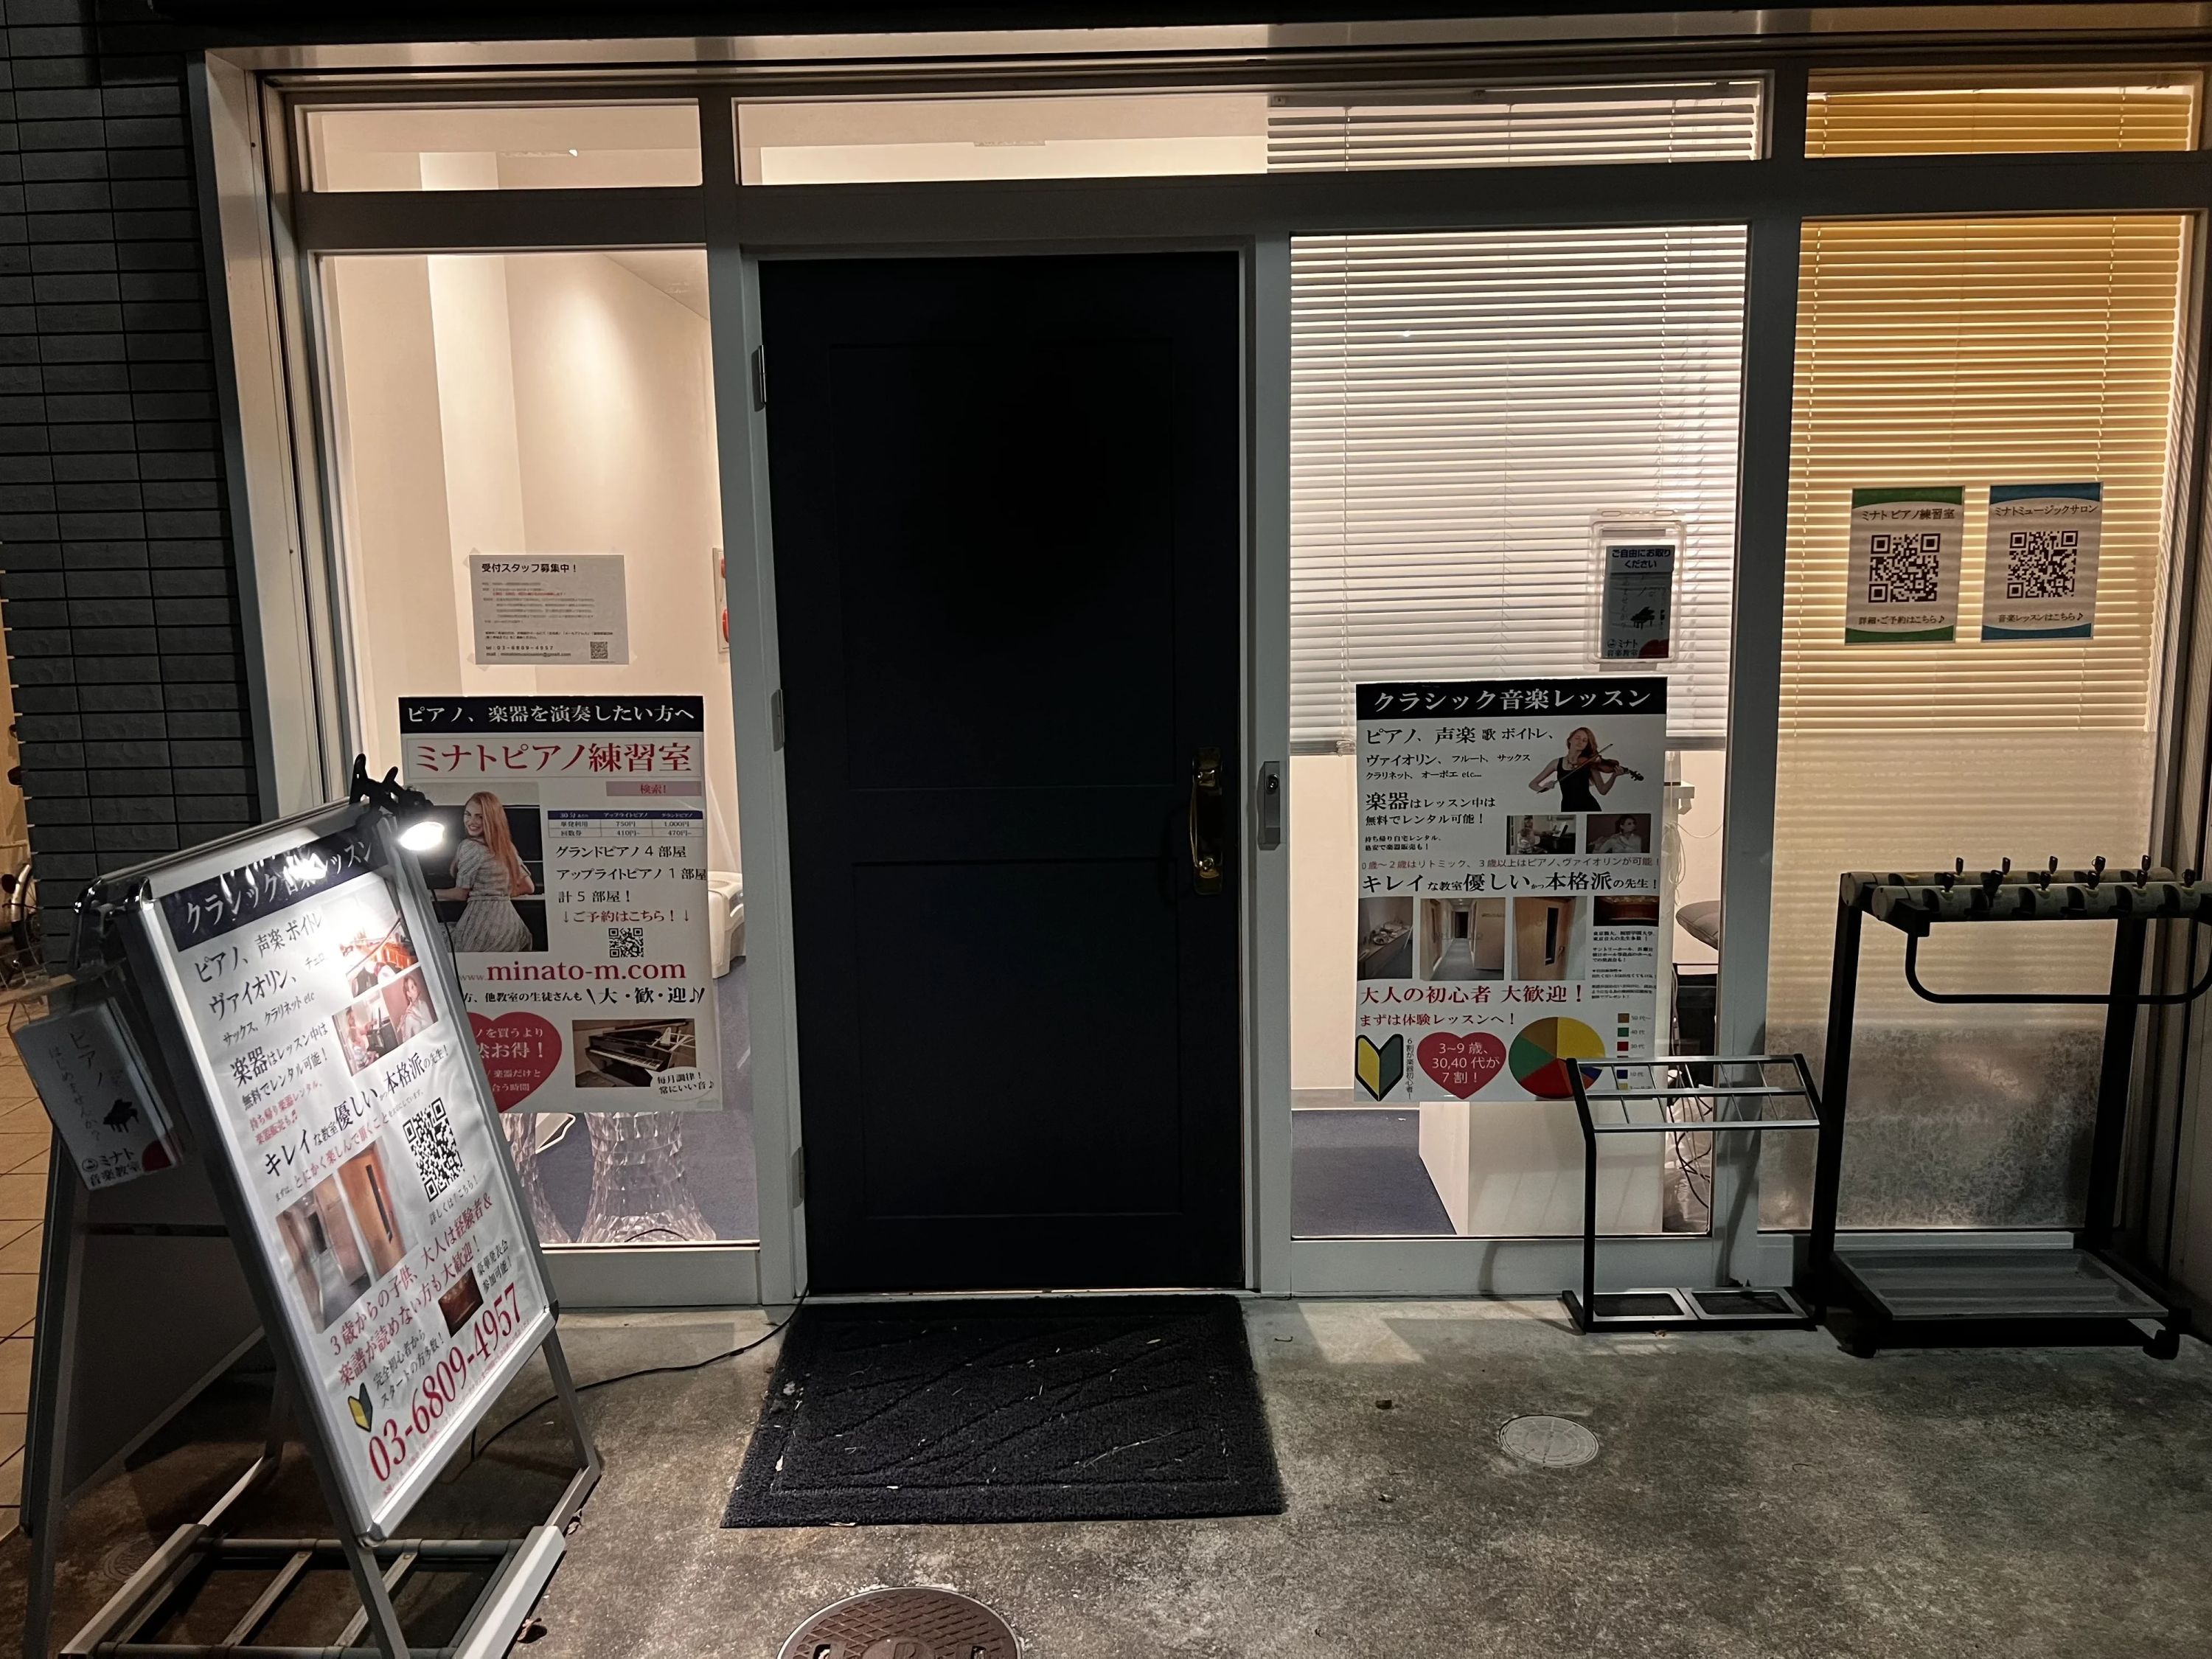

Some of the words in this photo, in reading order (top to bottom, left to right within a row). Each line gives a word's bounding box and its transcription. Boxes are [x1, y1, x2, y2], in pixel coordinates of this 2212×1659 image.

[1994, 504, 2098, 517] ミナトミュージックサロン
[1612, 549, 1672, 559] ご自由にお取り
[481, 563, 577, 574] 受付スタッフ募集中！
[1624, 560, 1658, 569] ください
[1374, 688, 1652, 713] クラシック音楽レッスン
[407, 704, 695, 723] ピアノ、楽器を演奏したい方へ
[416, 742, 692, 773] ミナトピアノ練習室
[1366, 791, 1496, 811] 楽器はレッスン中は
[1365, 813, 1484, 827] 無料でレンタル可能！
[1360, 985, 1491, 1005] 大人の初心者
[1500, 984, 1583, 1004] 大歓迎！
[1360, 1013, 1515, 1027] まずは体験レッスンへ！
[229, 1022, 329, 1088] 楽器はレッスン中は
[373, 1329, 426, 1388] 完全初心者から
[369, 1282, 521, 1483] 03-6809-4957
